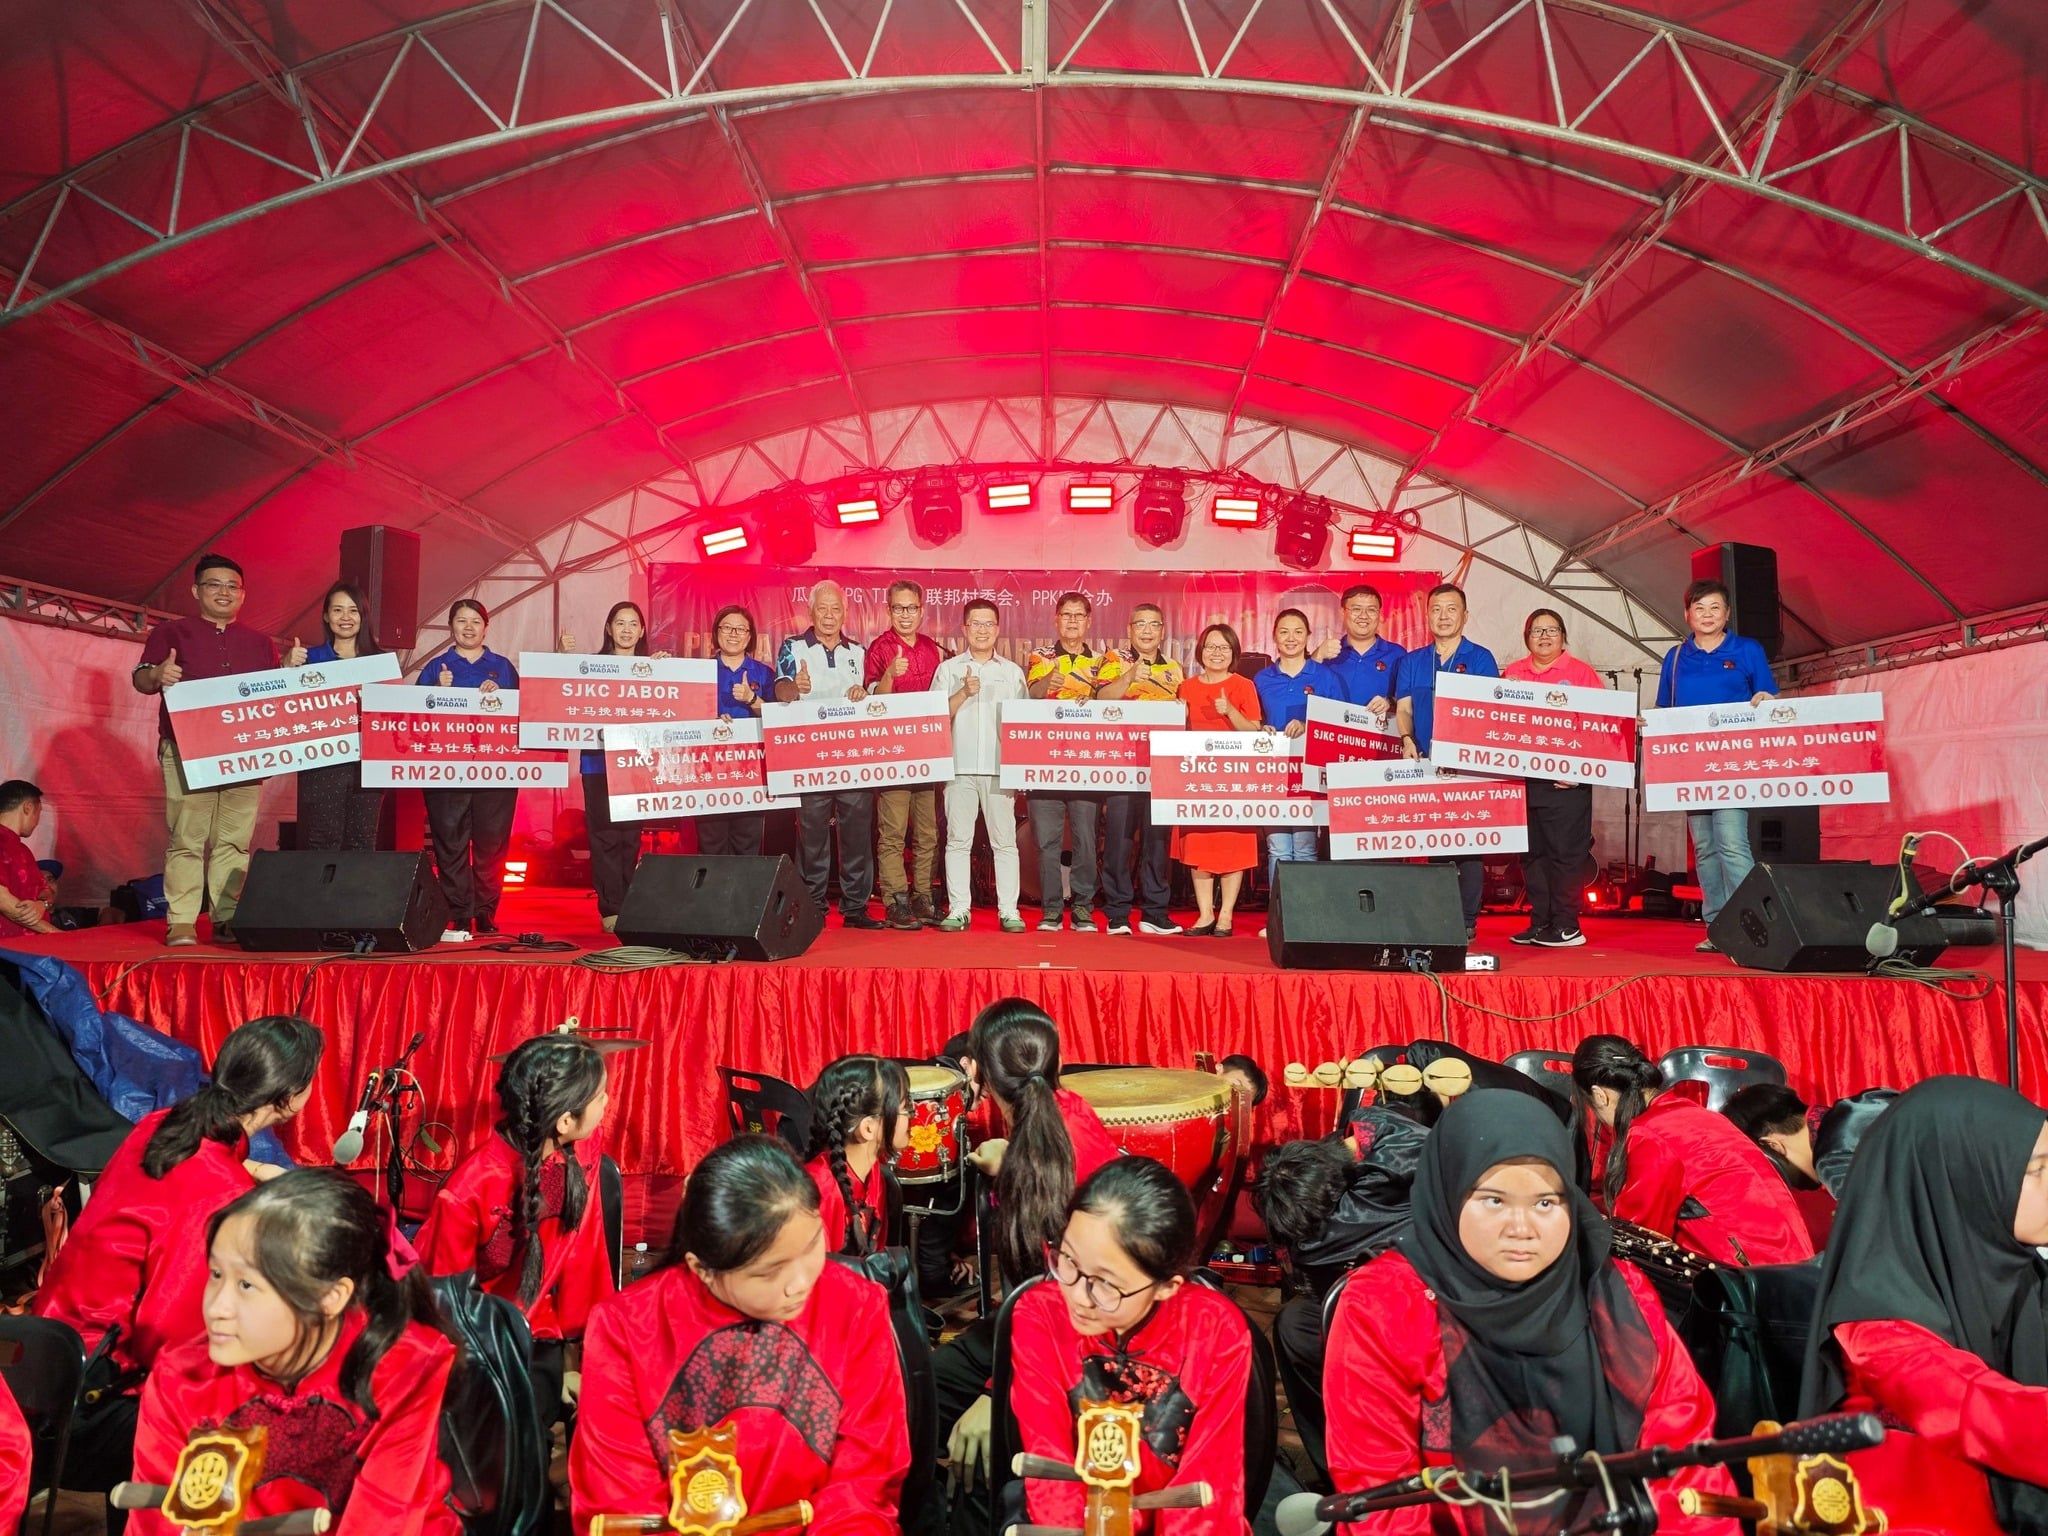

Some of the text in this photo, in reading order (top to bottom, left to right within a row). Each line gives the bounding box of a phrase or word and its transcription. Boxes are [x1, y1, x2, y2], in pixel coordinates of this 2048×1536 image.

[251, 684, 287, 694] MADANI
[562, 683, 680, 700] SJKC JABOR
[221, 690, 362, 724] SJKC CHUKA
[371, 720, 407, 731] SJKC
[413, 722, 441, 732] LOK
[446, 722, 495, 733] KHOON
[1452, 706, 1619, 734] SJKC CHEE MONG, PAKA
[774, 722, 942, 745] SJKC CHUNG HWA WEI SIN
[1009, 730, 1042, 740] SMJK
[1047, 731, 1091, 740] CHUNG
[1096, 731, 1123, 741] HWA
[1314, 729, 1334, 742] SJKC
[1337, 734, 1366, 748] CHUNG
[1369, 739, 1388, 752] HWA
[1485, 730, 1582, 749] 北加启蒙华小
[1652, 730, 1877, 755] SJKC KWANG HWA DUNGUN
[816, 744, 905, 760] 中华维新小学
[1049, 749, 1136, 759] 中华维新华中
[617, 757, 654, 767] SJKC
[1180, 762, 1217, 773] SJKC
[1224, 762, 1249, 773] SIN
[1459, 748, 1607, 779] RM20,000.00
[1704, 756, 1821, 773] 龙运光华小学
[391, 765, 543, 784] RM20,000.00
[794, 763, 930, 787] RM20,000.00
[1333, 789, 1521, 807] SJKC CHONG HWA, WAKAF TAPAI
[1676, 779, 1854, 803] RM20,000.00
[1176, 804, 1313, 820] RM20,000.00
[1356, 831, 1502, 851] RM20,000.00
